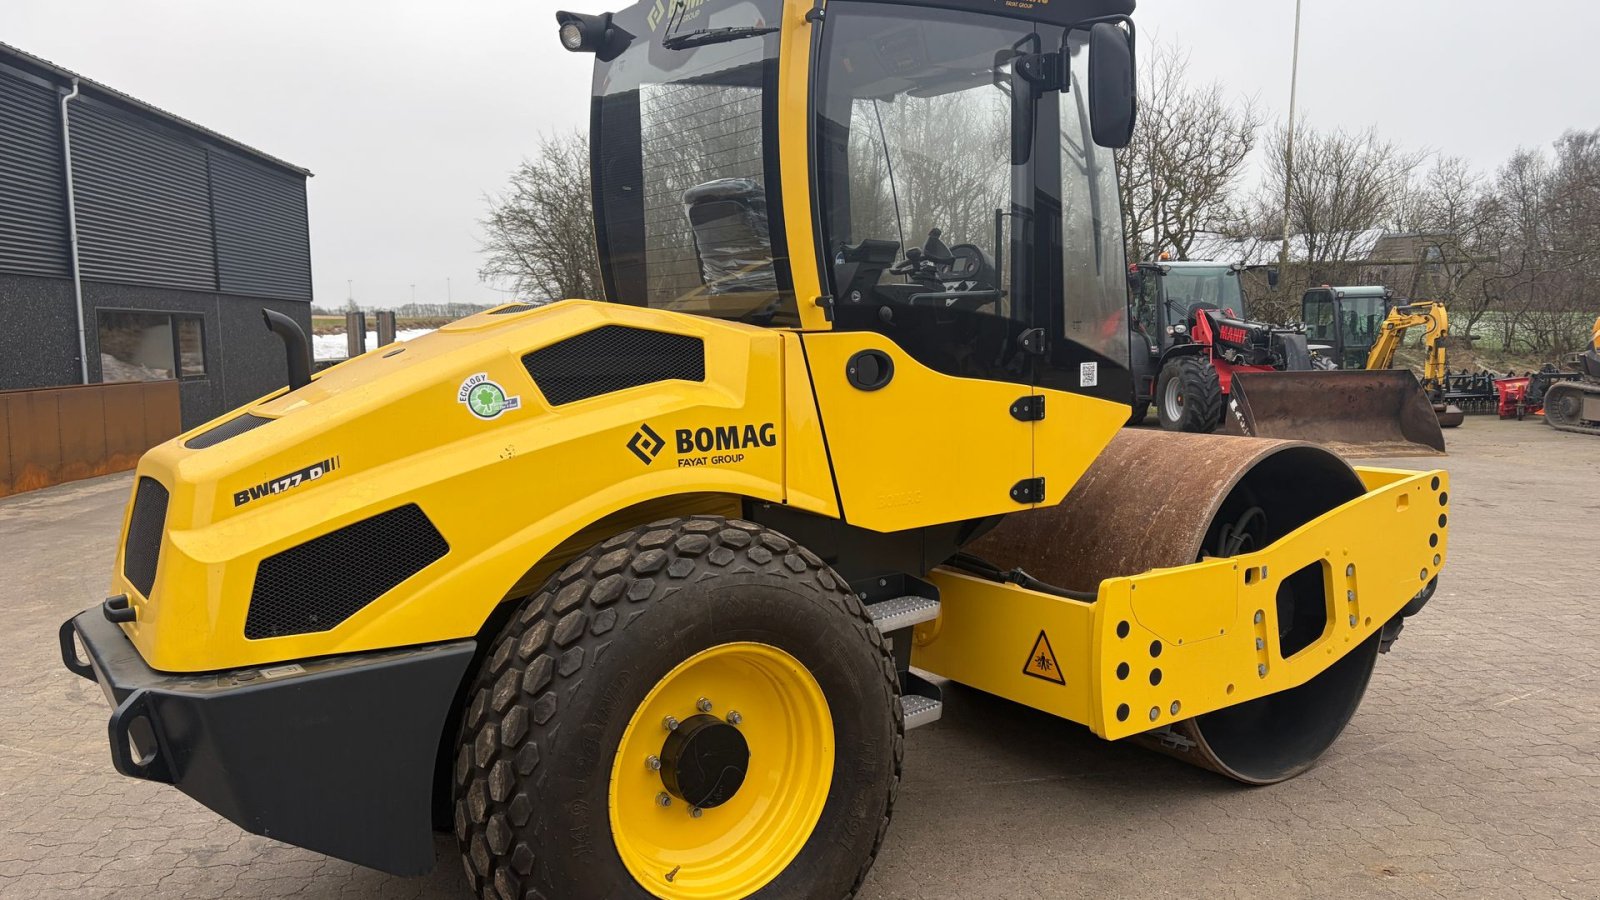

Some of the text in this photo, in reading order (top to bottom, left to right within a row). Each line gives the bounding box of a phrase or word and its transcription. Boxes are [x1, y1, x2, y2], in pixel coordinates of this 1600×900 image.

[459, 374, 486, 402] ECOLOGY
[675, 423, 777, 454] BOMAG
[677, 454, 745, 468] FAYAT GROUP
